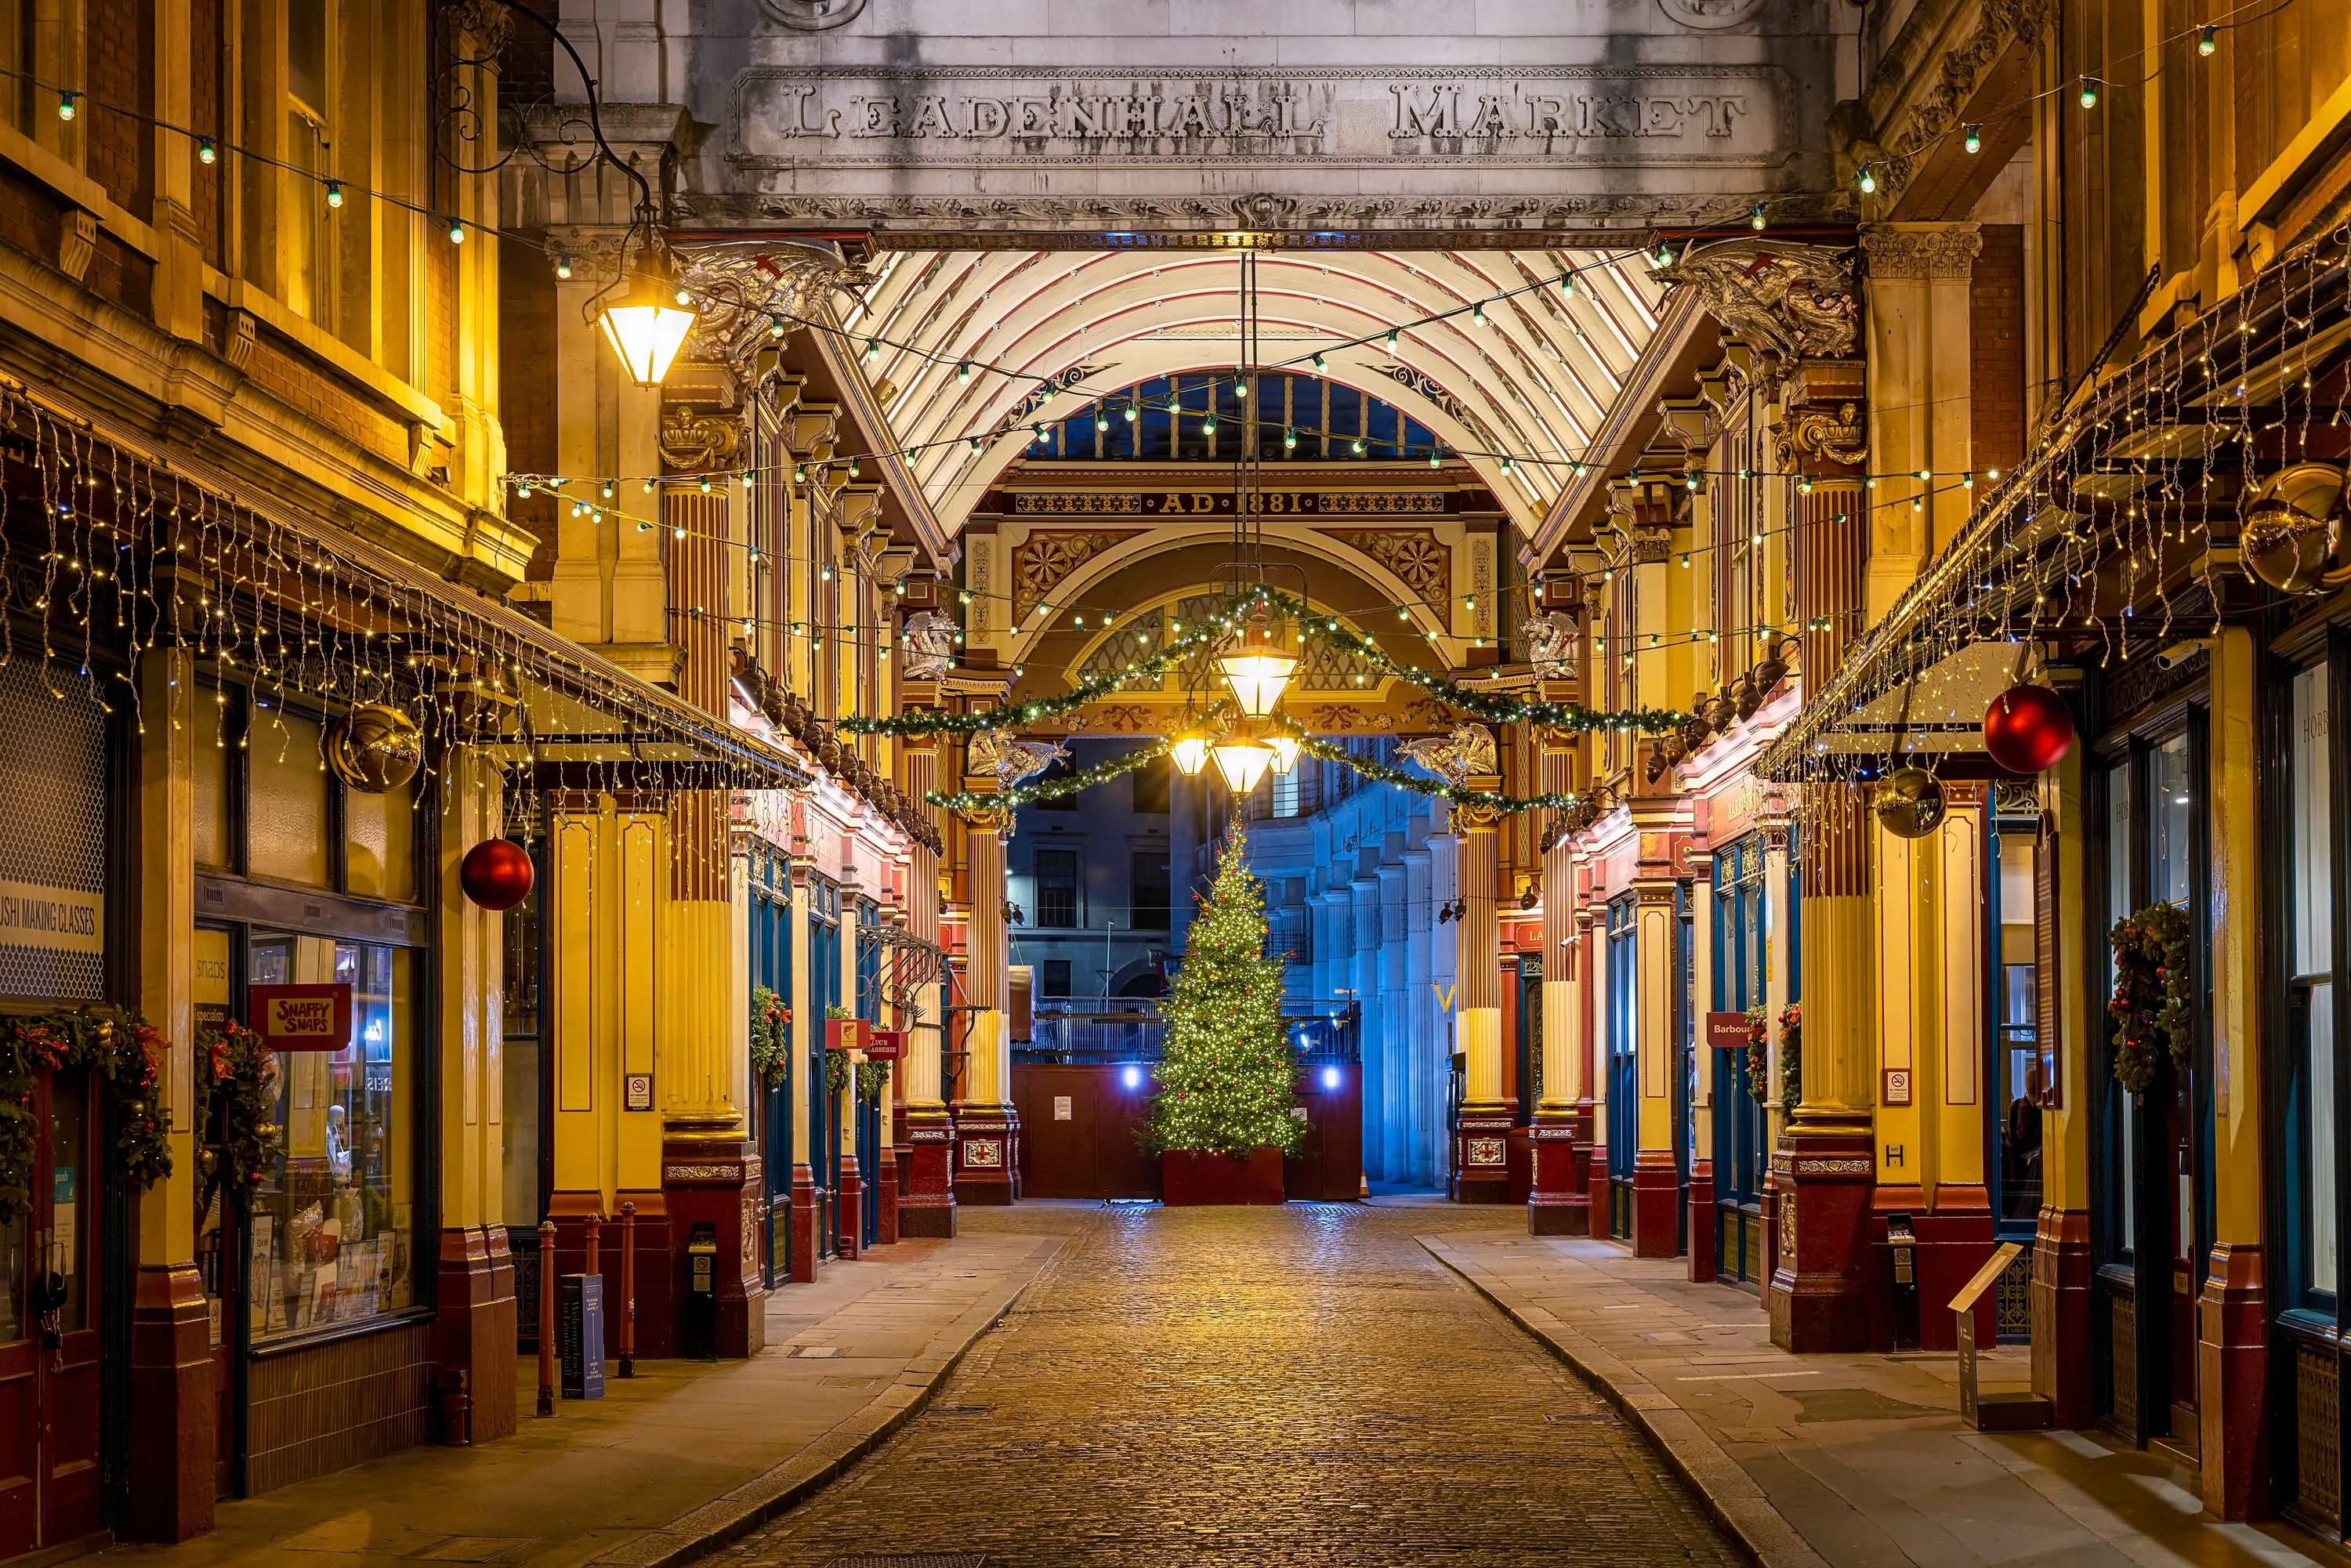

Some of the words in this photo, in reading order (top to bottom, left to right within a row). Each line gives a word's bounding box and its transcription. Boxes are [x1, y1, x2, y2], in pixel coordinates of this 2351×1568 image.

[781, 82, 1325, 140] LEADENHALL
[1388, 82, 1748, 139] MARKET
[1236, 493, 1302, 513] 1881
[21, 898, 57, 932] MAKING
[58, 903, 95, 937] CLASSES
[196, 959, 226, 987] snaps
[196, 1007, 225, 1026] specialists
[276, 1000, 331, 1022] SNAPPY
[284, 1018, 328, 1034] SNAPS
[56, 1170, 68, 1186] push
